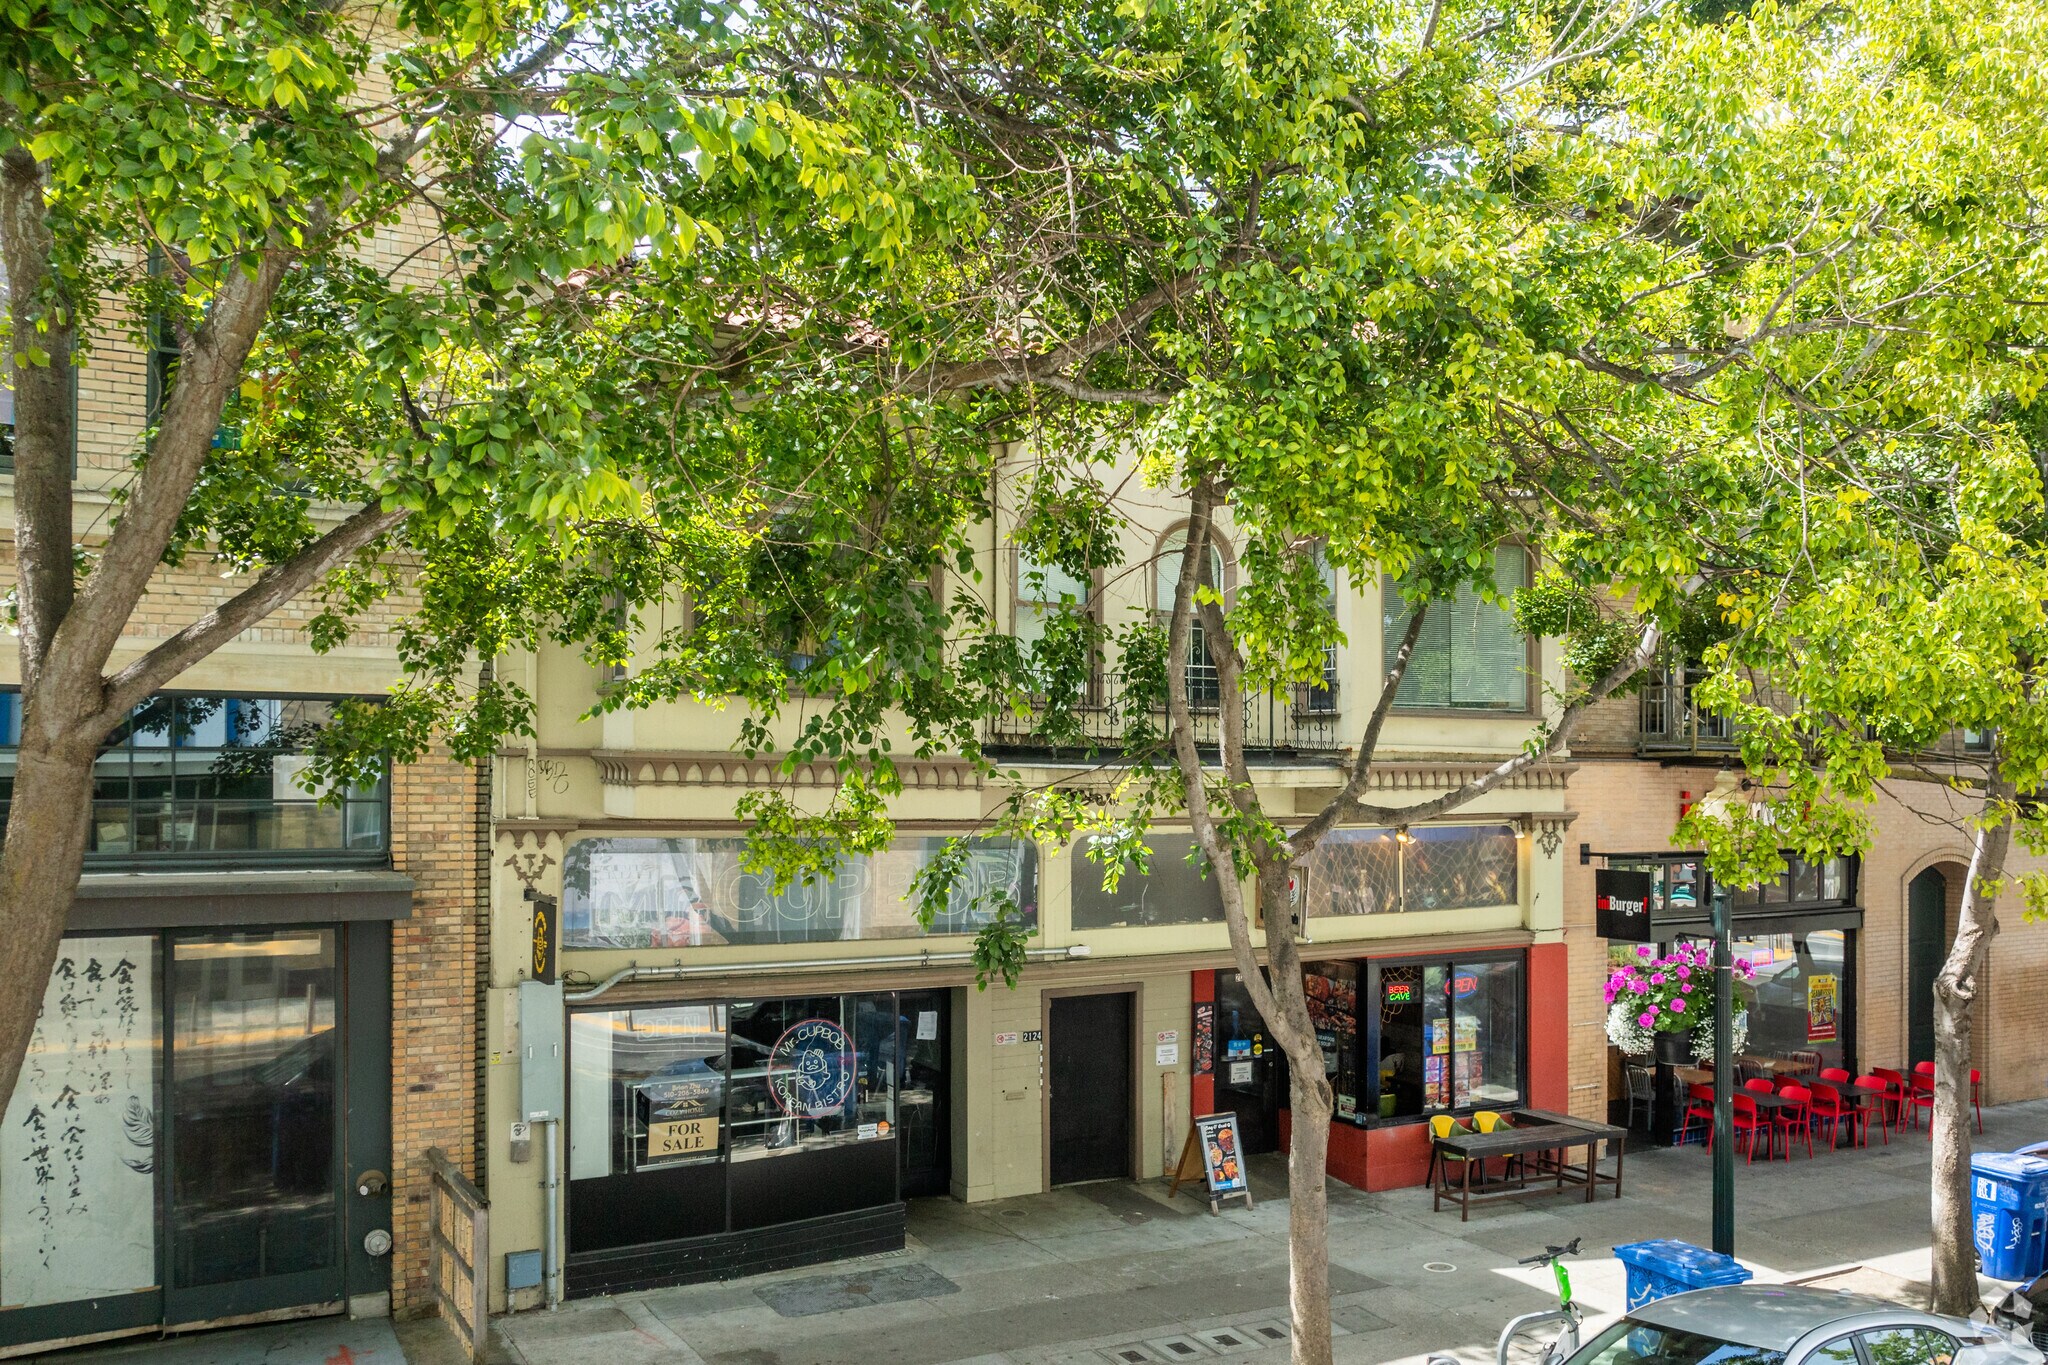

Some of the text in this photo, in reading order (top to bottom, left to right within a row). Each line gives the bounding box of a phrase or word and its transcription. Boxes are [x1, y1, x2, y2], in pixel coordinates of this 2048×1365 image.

[1387, 984, 1410, 994] BEER
[1389, 992, 1411, 1001] CAVE
[641, 1015, 697, 1038] OPEN
[780, 1025, 845, 1056] Mr. CUPBOB
[1023, 1031, 1042, 1042] 2124
[775, 1071, 850, 1112] KOREAN BISTRO
[668, 1122, 701, 1137] FOR
[662, 1135, 704, 1152] SALE
